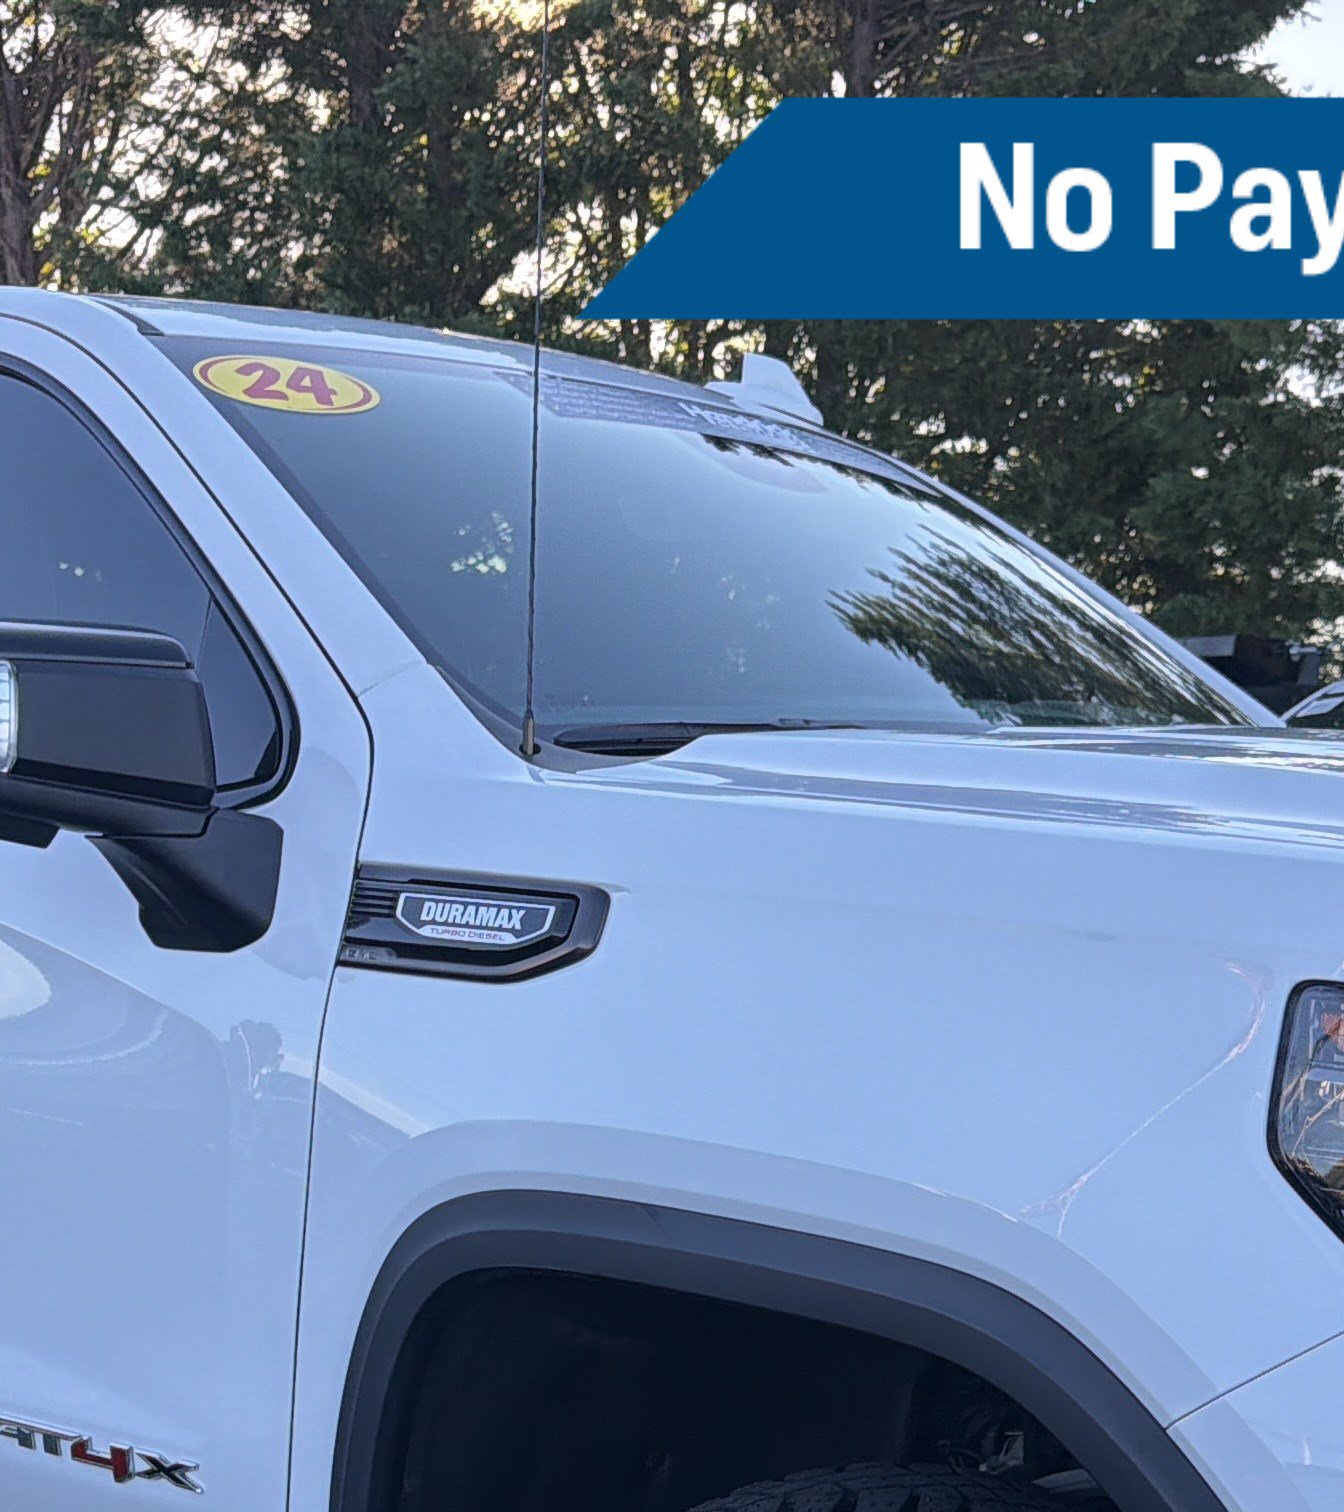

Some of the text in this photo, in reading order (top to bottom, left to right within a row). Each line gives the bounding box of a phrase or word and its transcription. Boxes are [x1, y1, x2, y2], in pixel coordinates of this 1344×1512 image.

[235, 362, 338, 406] 24
[420, 901, 527, 930] DURAMAX
[429, 927, 506, 942] TURBO DIESEL
